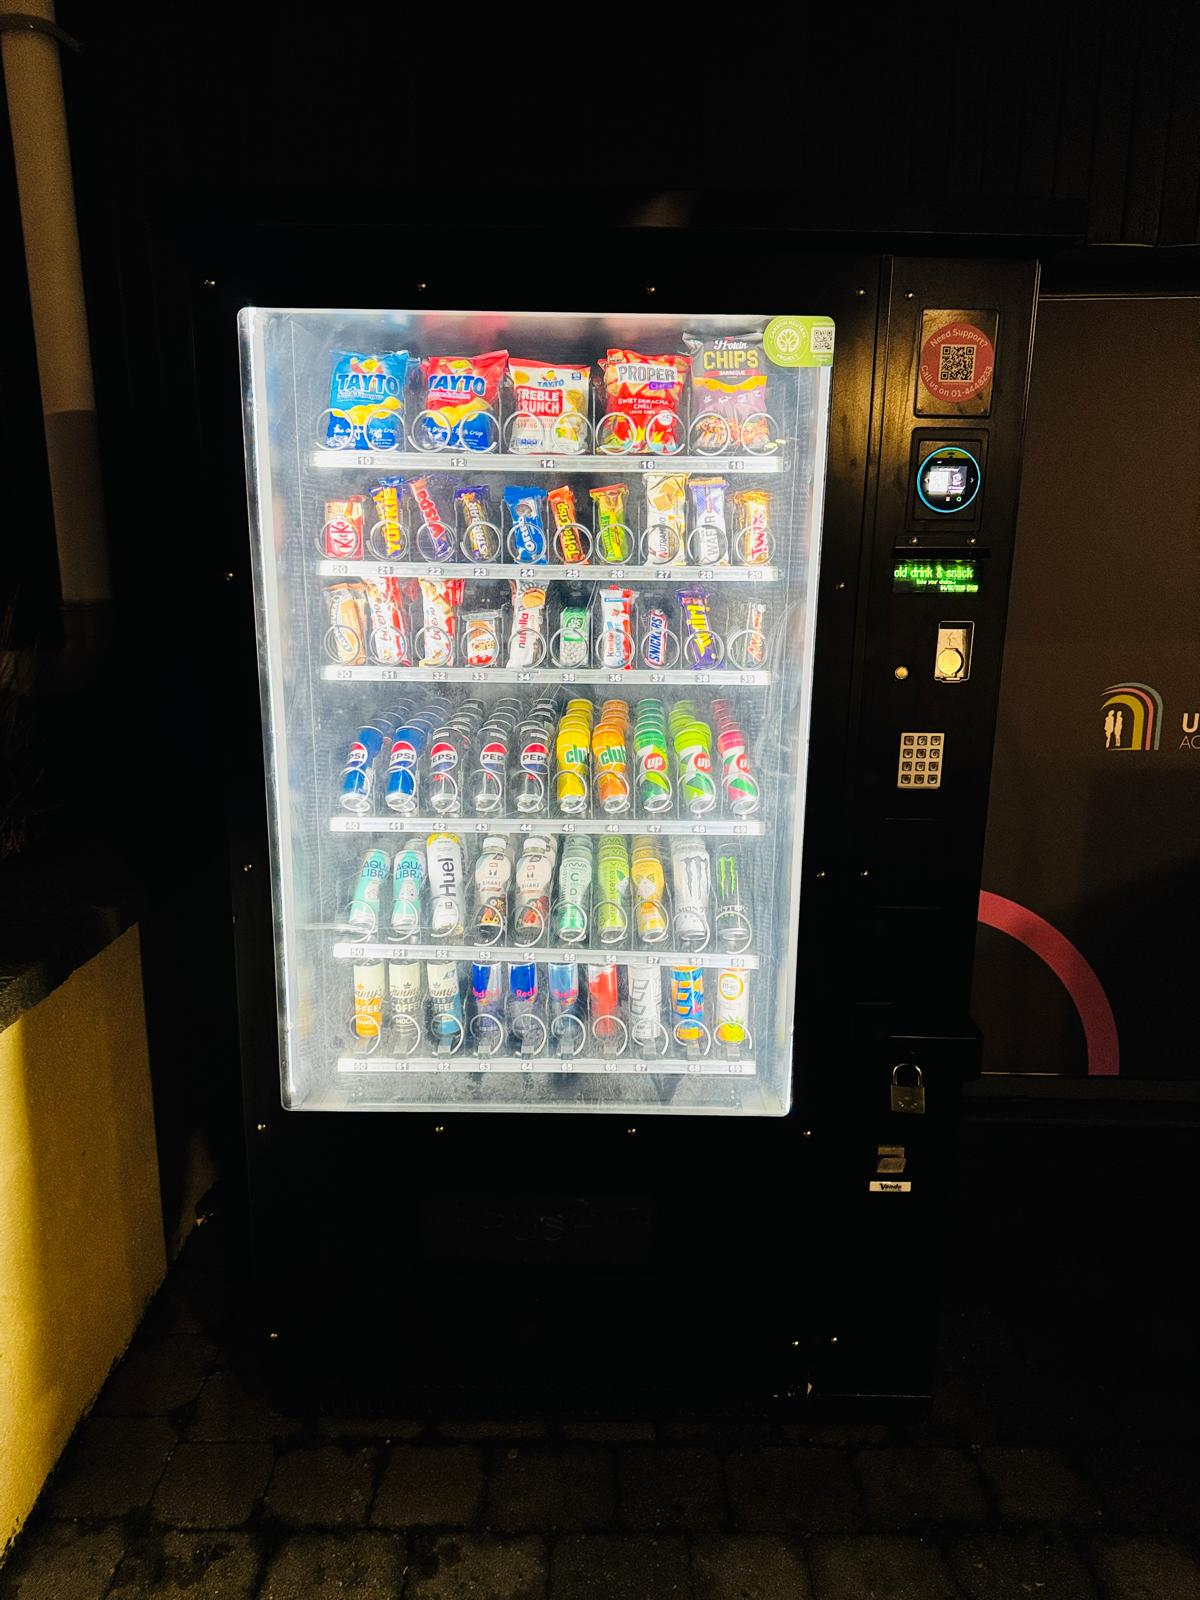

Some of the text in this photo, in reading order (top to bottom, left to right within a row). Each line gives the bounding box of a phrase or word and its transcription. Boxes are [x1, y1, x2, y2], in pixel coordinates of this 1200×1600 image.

[714, 339, 749, 351] Protein
[930, 328, 989, 348] Need Support?
[703, 350, 760, 370] CHIPS
[537, 379, 565, 387] TAYTO
[618, 365, 676, 382] PROPER
[921, 365, 933, 383] Call
[930, 382, 939, 391] us
[938, 387, 949, 396] on
[337, 373, 399, 396] TAYTO
[428, 374, 487, 396] TAYTO
[415, 488, 446, 540] Wispa
[331, 521, 353, 549] KitKa
[894, 565, 974, 578] old drink & snack
[396, 860, 423, 871] AQUA
[438, 857, 456, 897] Huel
[570, 873, 579, 882] C
